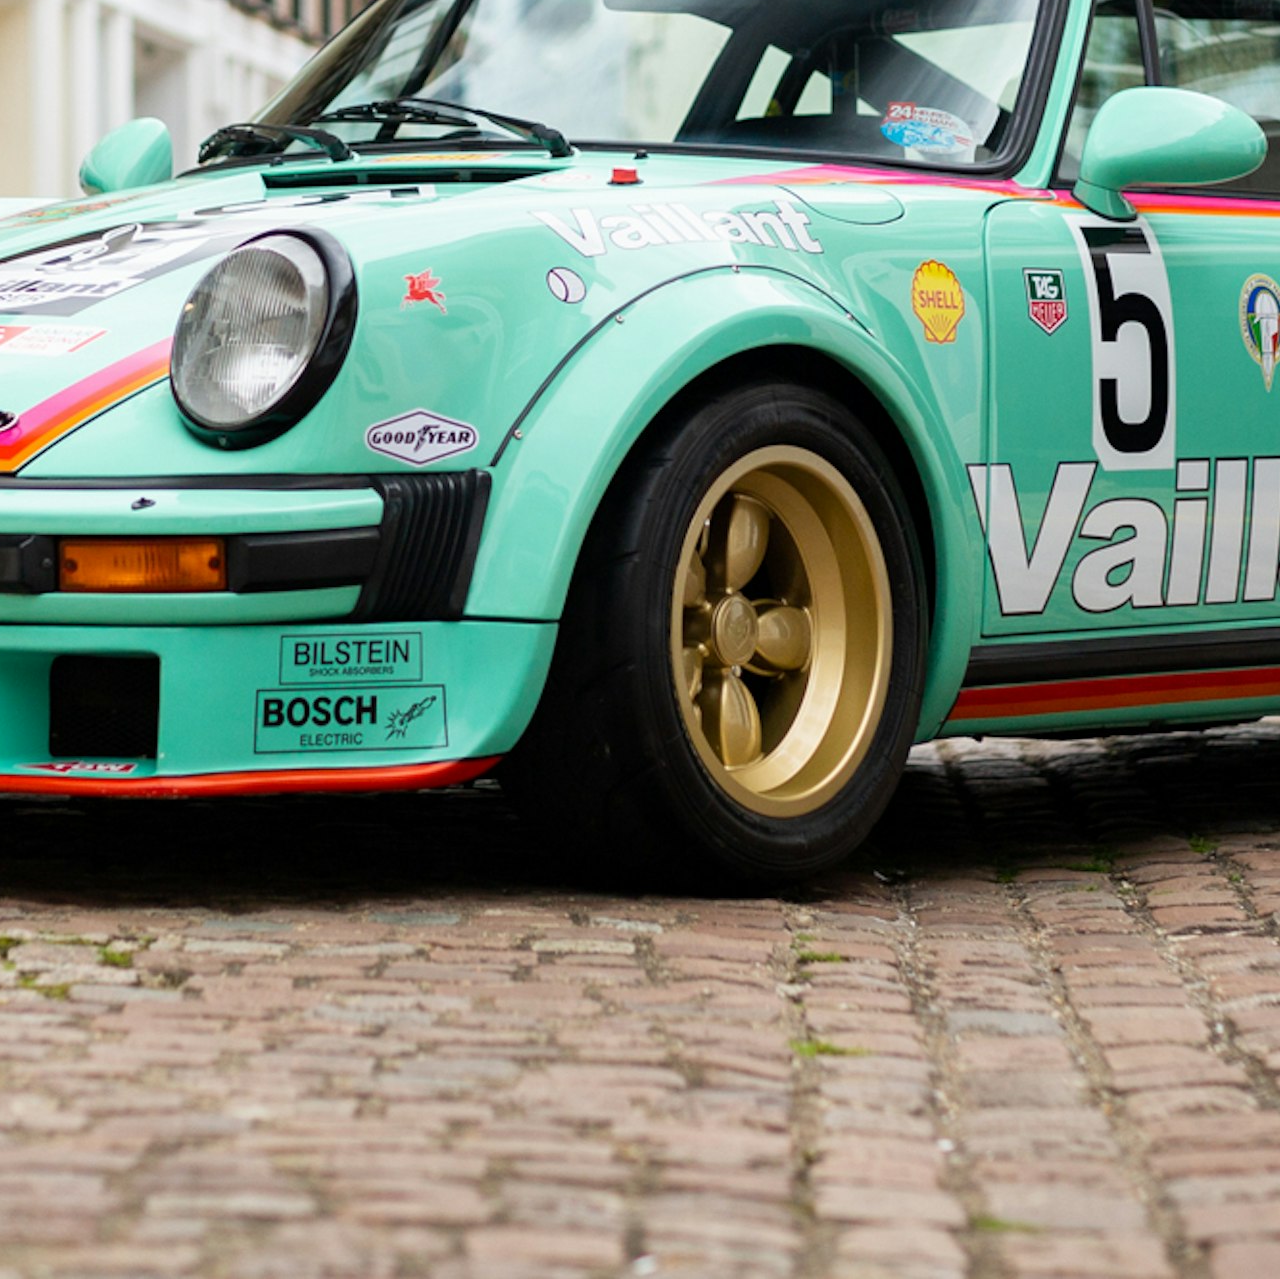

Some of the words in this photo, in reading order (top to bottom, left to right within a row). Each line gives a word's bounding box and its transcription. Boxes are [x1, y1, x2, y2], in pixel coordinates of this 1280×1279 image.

[889, 104, 912, 118] 24
[528, 198, 824, 259] Vaillant
[918, 288, 960, 311] SHELL
[1031, 275, 1060, 299] TAG
[1031, 301, 1065, 328] HEUER
[1079, 226, 1170, 454] 5
[293, 639, 410, 666] BILSTEIN
[308, 667, 339, 677] SHOCK
[342, 666, 394, 676] ABSORBERS
[262, 695, 378, 728] BOSCH
[299, 732, 364, 747] ELECTRIC
